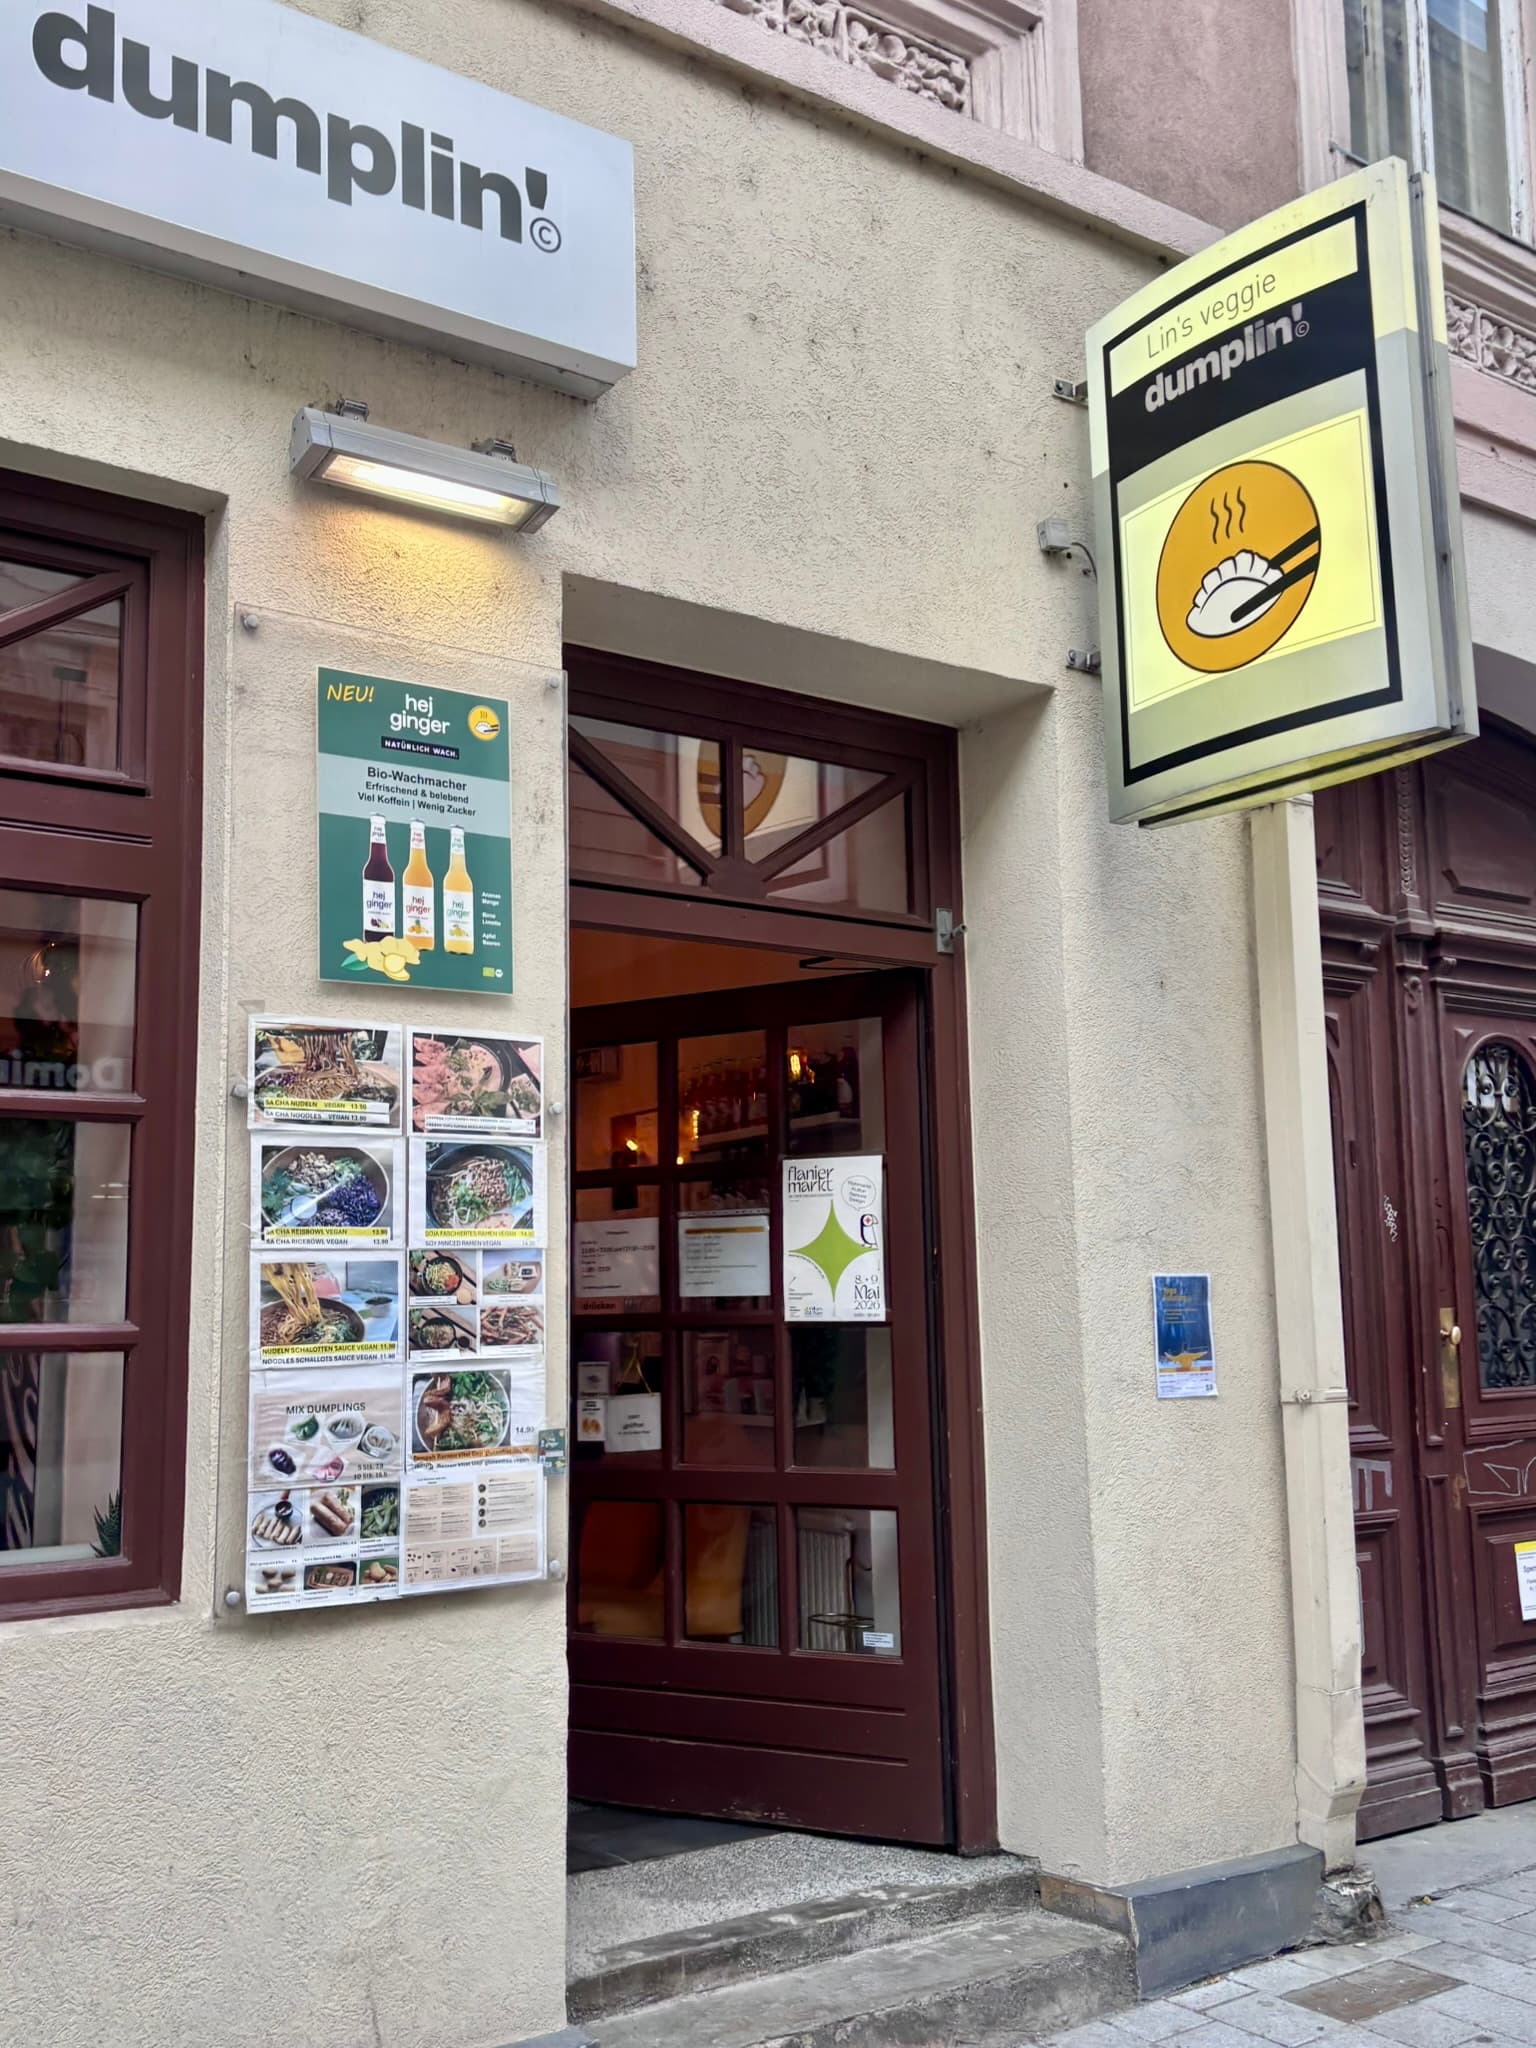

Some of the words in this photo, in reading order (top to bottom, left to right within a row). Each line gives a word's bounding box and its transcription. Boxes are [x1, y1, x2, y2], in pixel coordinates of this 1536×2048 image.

[1146, 315, 1194, 359] Lin's
[1200, 273, 1277, 326] veggie
[326, 683, 375, 703] NEU!
[404, 693, 434, 718] hej
[389, 710, 451, 736] ginger
[384, 739, 431, 754] NATÜRLICH
[367, 766, 468, 792] Bio-Wachmacher
[365, 781, 419, 797] Erfrischend
[420, 789, 428, 798] &
[429, 790, 470, 804] belebend
[357, 791, 376, 802] Viel
[377, 794, 411, 808] Koffein
[417, 800, 446, 814] Wenig
[447, 804, 477, 817] Zucker
[291, 1100, 318, 1108] NUDELN
[325, 1228, 348, 1236] VEGAN
[854, 1284, 880, 1300] Mai
[262, 1347, 290, 1355] NUDELN
[357, 1343, 378, 1351] VEGAN
[356, 1353, 378, 1361] VEGAN
[286, 1405, 305, 1415] MIX
[307, 1402, 366, 1413] DUMPLINGS
